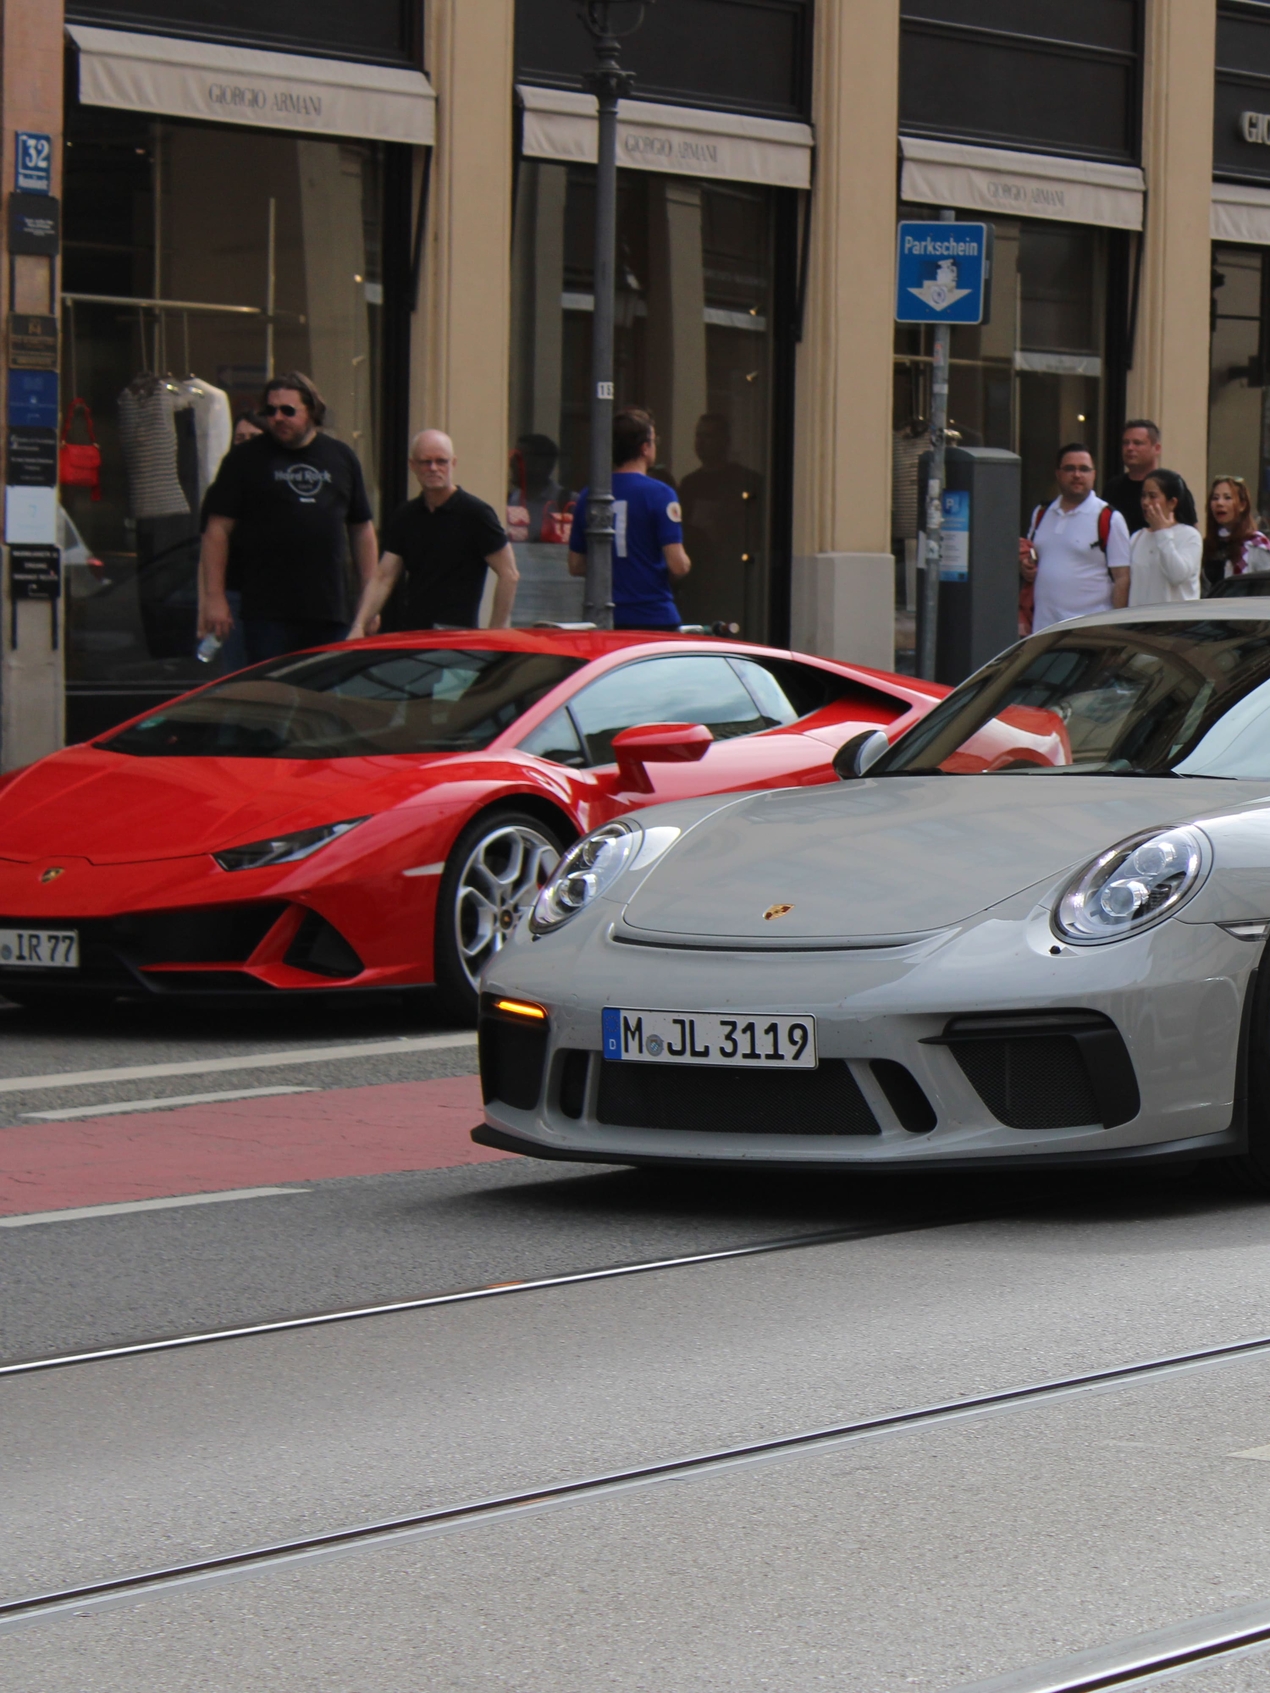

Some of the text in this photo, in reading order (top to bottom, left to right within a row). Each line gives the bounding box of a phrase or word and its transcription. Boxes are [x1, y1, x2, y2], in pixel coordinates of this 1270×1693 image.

[208, 83, 322, 116] GIORGIO ARMANI
[26, 140, 49, 168] 32
[904, 236, 979, 256] Parkschein
[16, 933, 75, 962] IR 77
[623, 1015, 809, 1061] M JL 3119
